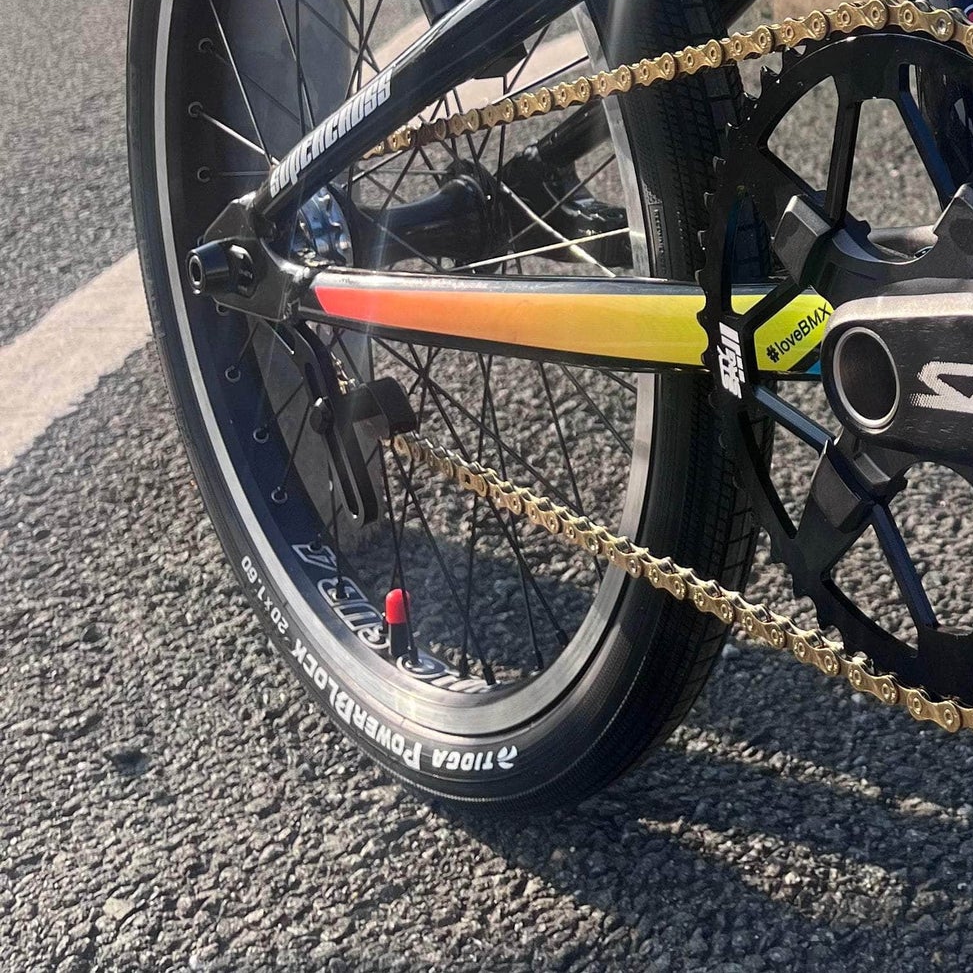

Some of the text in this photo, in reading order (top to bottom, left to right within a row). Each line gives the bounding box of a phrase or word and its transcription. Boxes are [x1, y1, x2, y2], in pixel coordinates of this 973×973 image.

[270, 69, 392, 198] SUPERCROSS
[766, 302, 833, 363] #loveBMX
[431, 748, 494, 771] TIOGA
